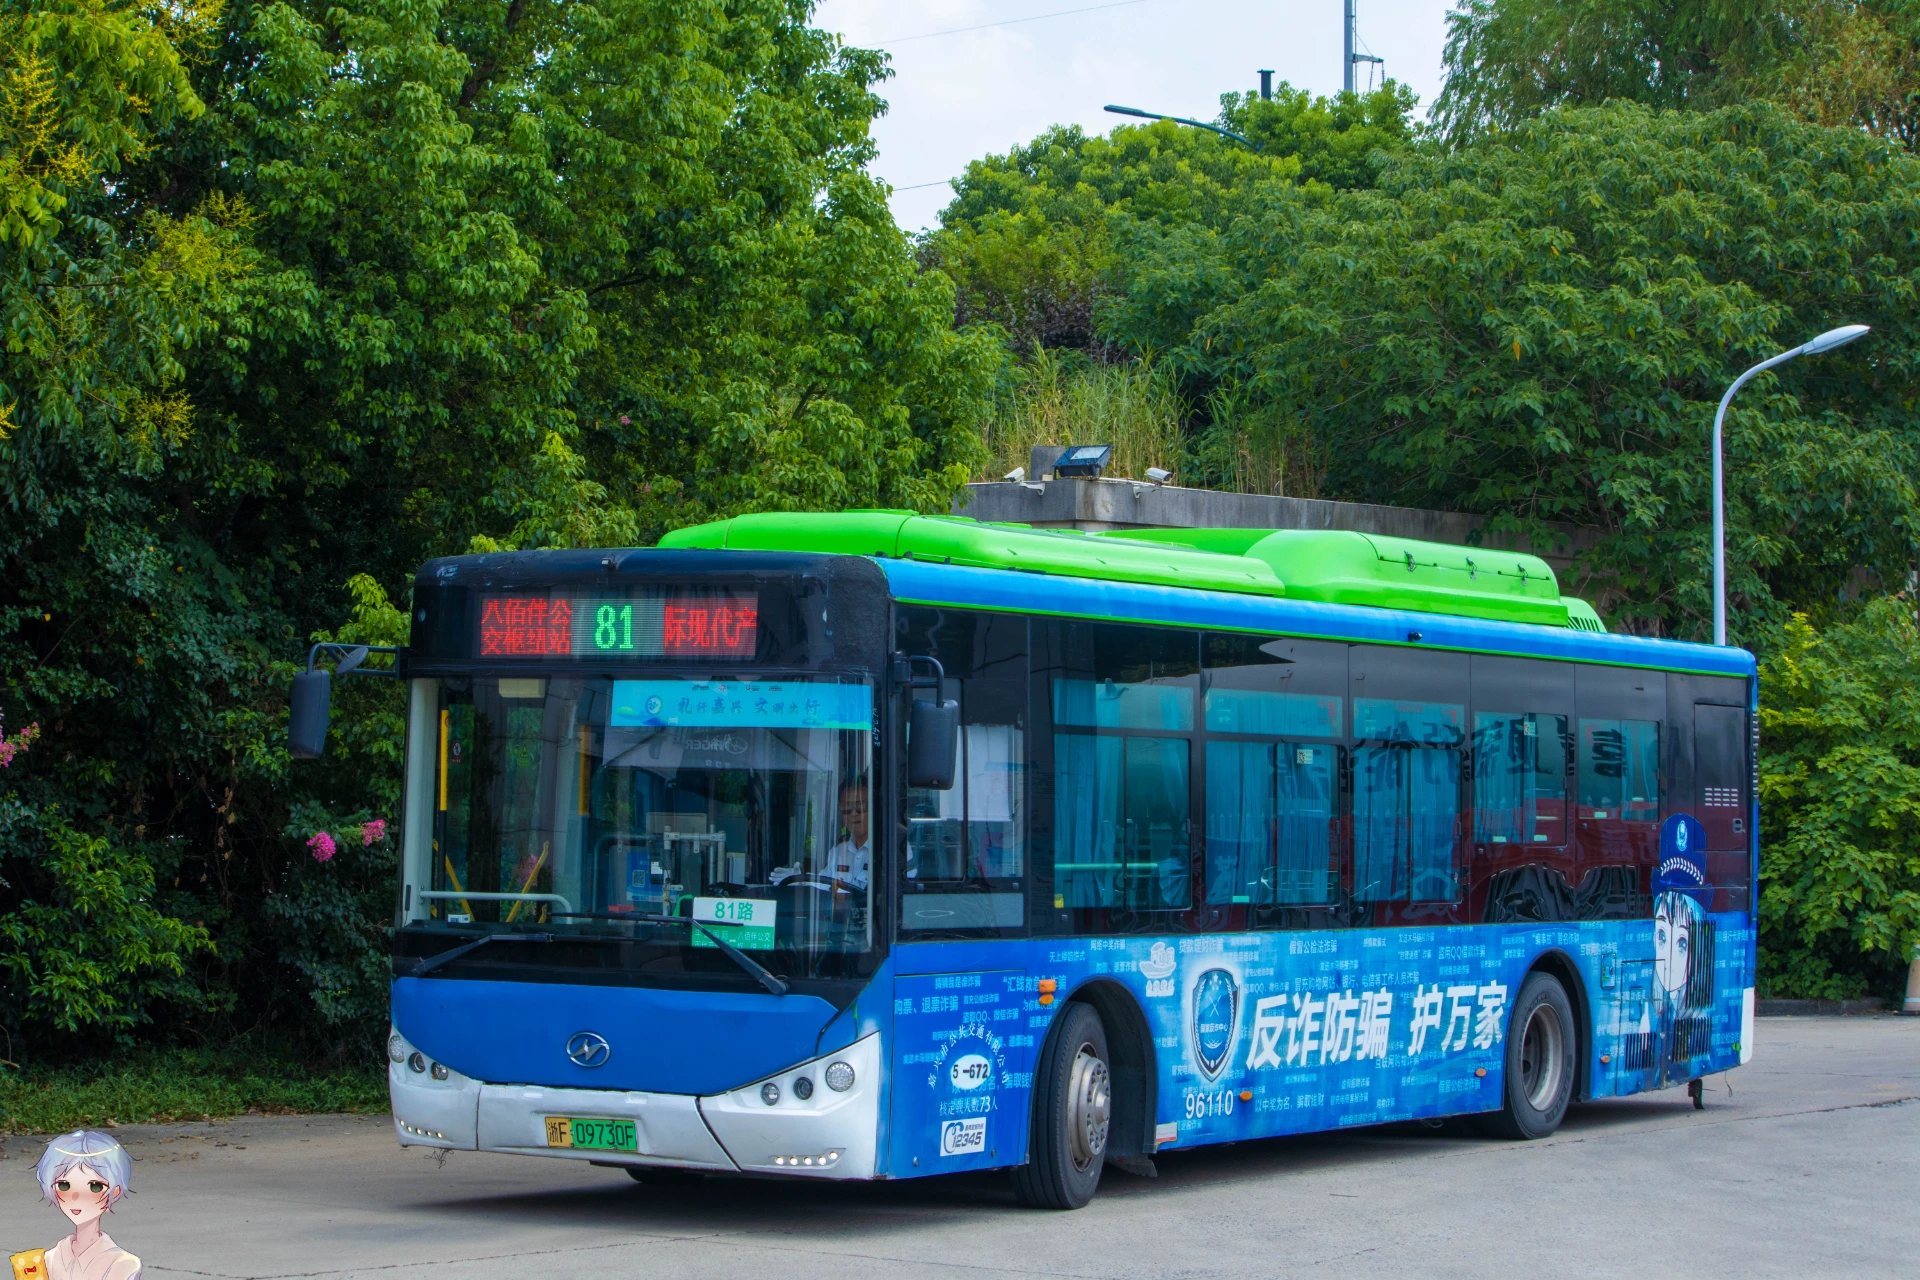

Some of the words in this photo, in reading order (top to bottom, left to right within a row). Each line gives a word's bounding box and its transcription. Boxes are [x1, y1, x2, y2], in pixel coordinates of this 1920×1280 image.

[481, 598, 572, 625] 八佰伴公
[595, 605, 634, 649] 81
[664, 606, 757, 647] 际现代产
[481, 626, 572, 655] 交枢纽站
[678, 696, 743, 715] 礼行嘉兴
[753, 697, 821, 716] 文明出行
[714, 901, 753, 921] 81路
[1289, 939, 1338, 955] 假冒公检法诈骗
[894, 995, 959, 1015] 购票、退票诈骗
[1245, 985, 1393, 1070] 反诈防骗
[1407, 979, 1508, 1056] 护万家
[1185, 1089, 1234, 1119] 96110
[1254, 1092, 1325, 1113] 以中奖为名，骗取钱财
[548, 1121, 567, 1143] 浙F
[575, 1122, 634, 1147] 09730F
[952, 1131, 983, 1149] 12345
